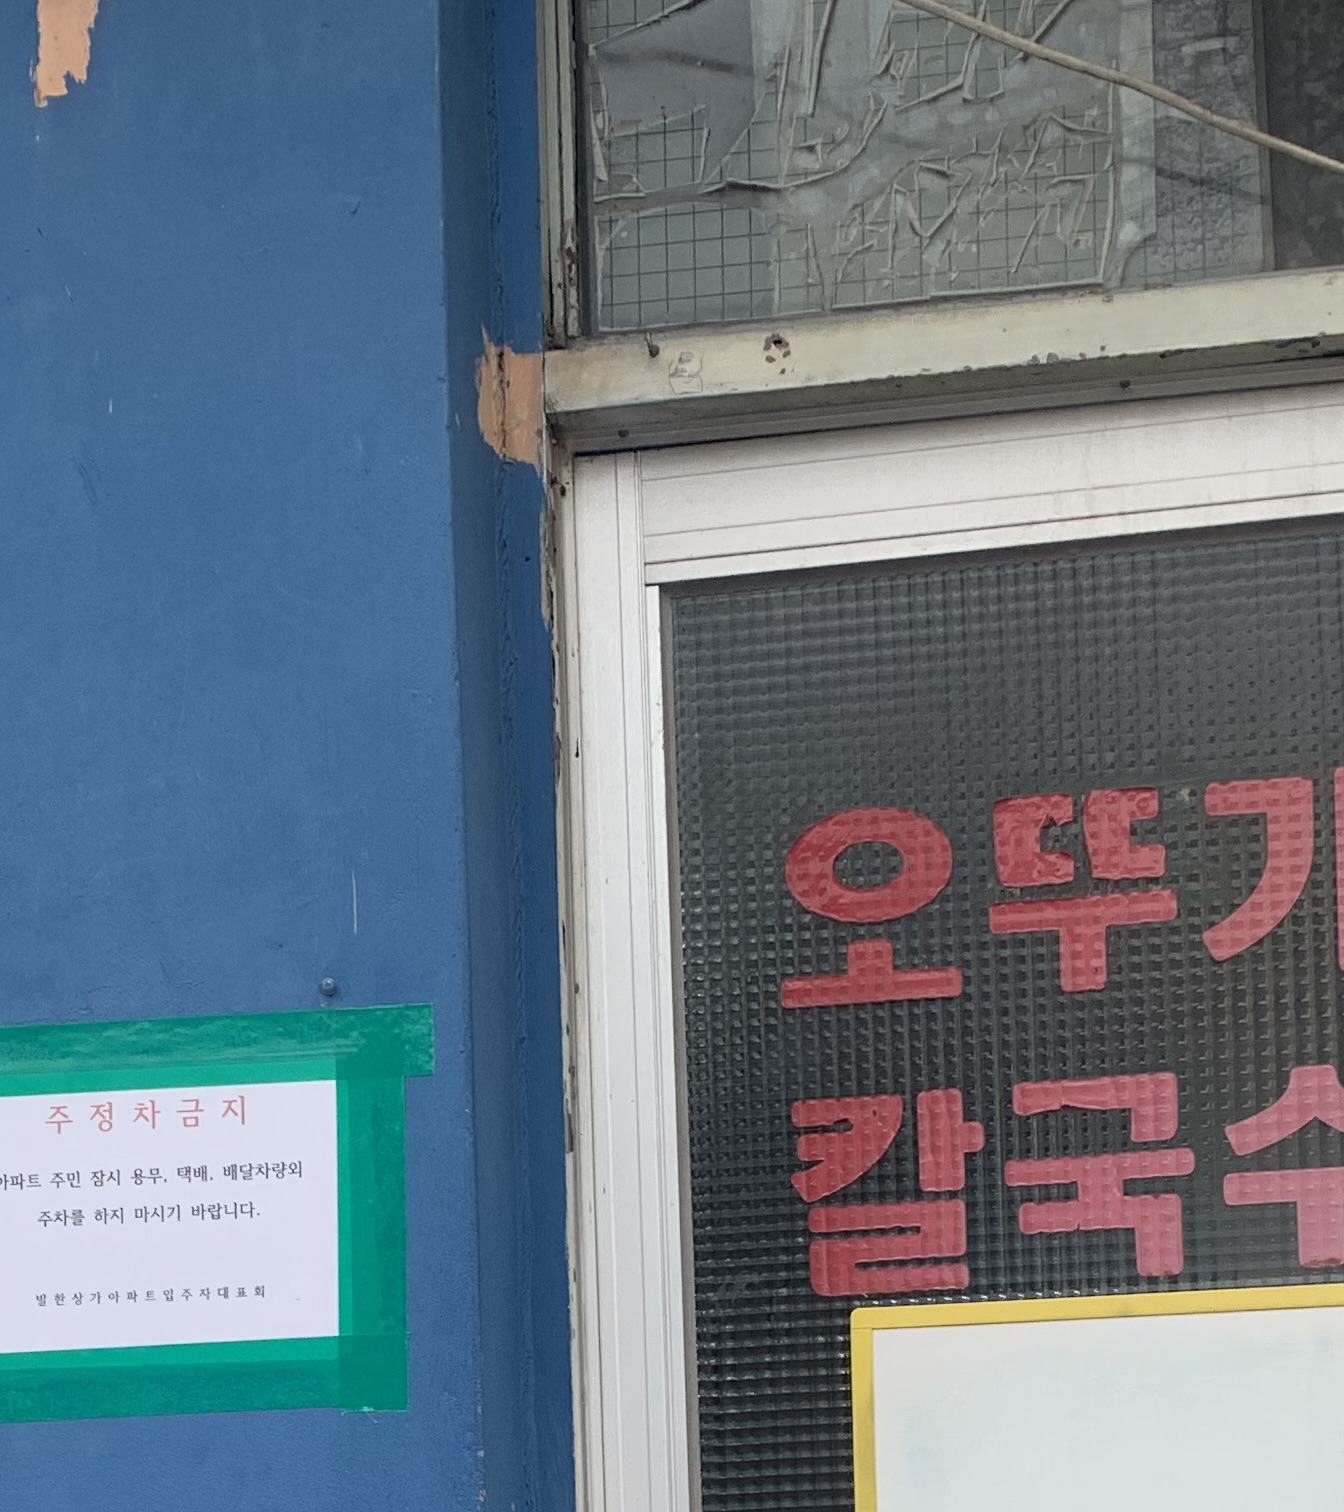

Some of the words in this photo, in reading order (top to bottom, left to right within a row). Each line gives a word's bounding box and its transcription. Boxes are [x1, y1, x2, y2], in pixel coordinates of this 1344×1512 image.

[45, 1095, 247, 1135] 주정차금지
[49, 1170, 82, 1188] 주민
[90, 1168, 122, 1187] 잠시
[222, 1160, 304, 1181] 배달차량외
[37, 1209, 86, 1227] 주차를
[94, 1207, 125, 1225] 하지
[134, 1204, 182, 1223] 마시기
[191, 1201, 261, 1221] 바랍니다.
